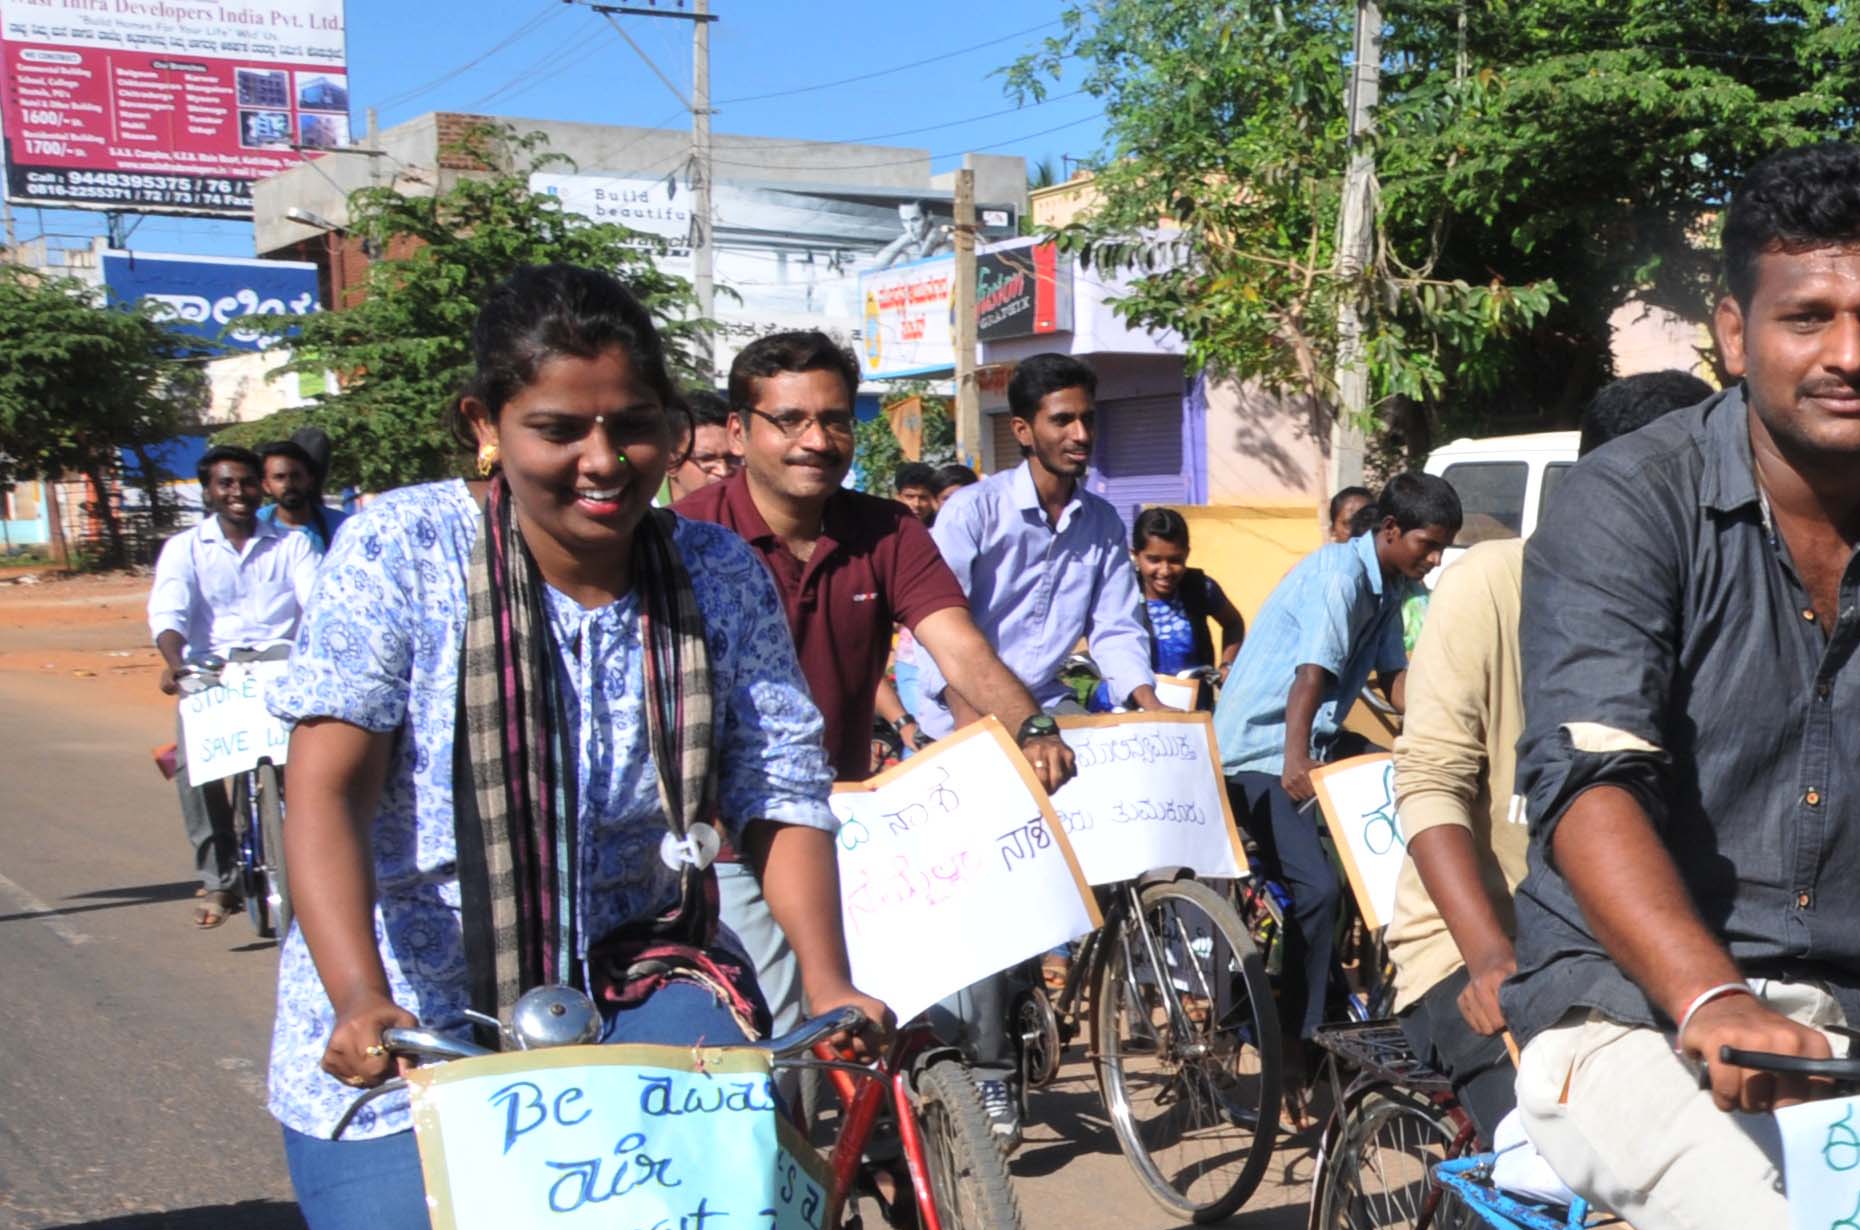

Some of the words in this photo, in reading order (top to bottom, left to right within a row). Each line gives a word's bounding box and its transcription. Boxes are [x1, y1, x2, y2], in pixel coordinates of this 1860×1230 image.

[116, 0, 213, 24] Developers
[219, 6, 264, 25] India
[271, 10, 304, 28] Pvt.
[309, 13, 345, 31] Ltd.
[595, 188, 649, 203] Build
[200, 730, 249, 762] SAVE
[488, 1080, 593, 1155] Be
[637, 1073, 777, 1117] awa
[545, 1132, 683, 1213] air
